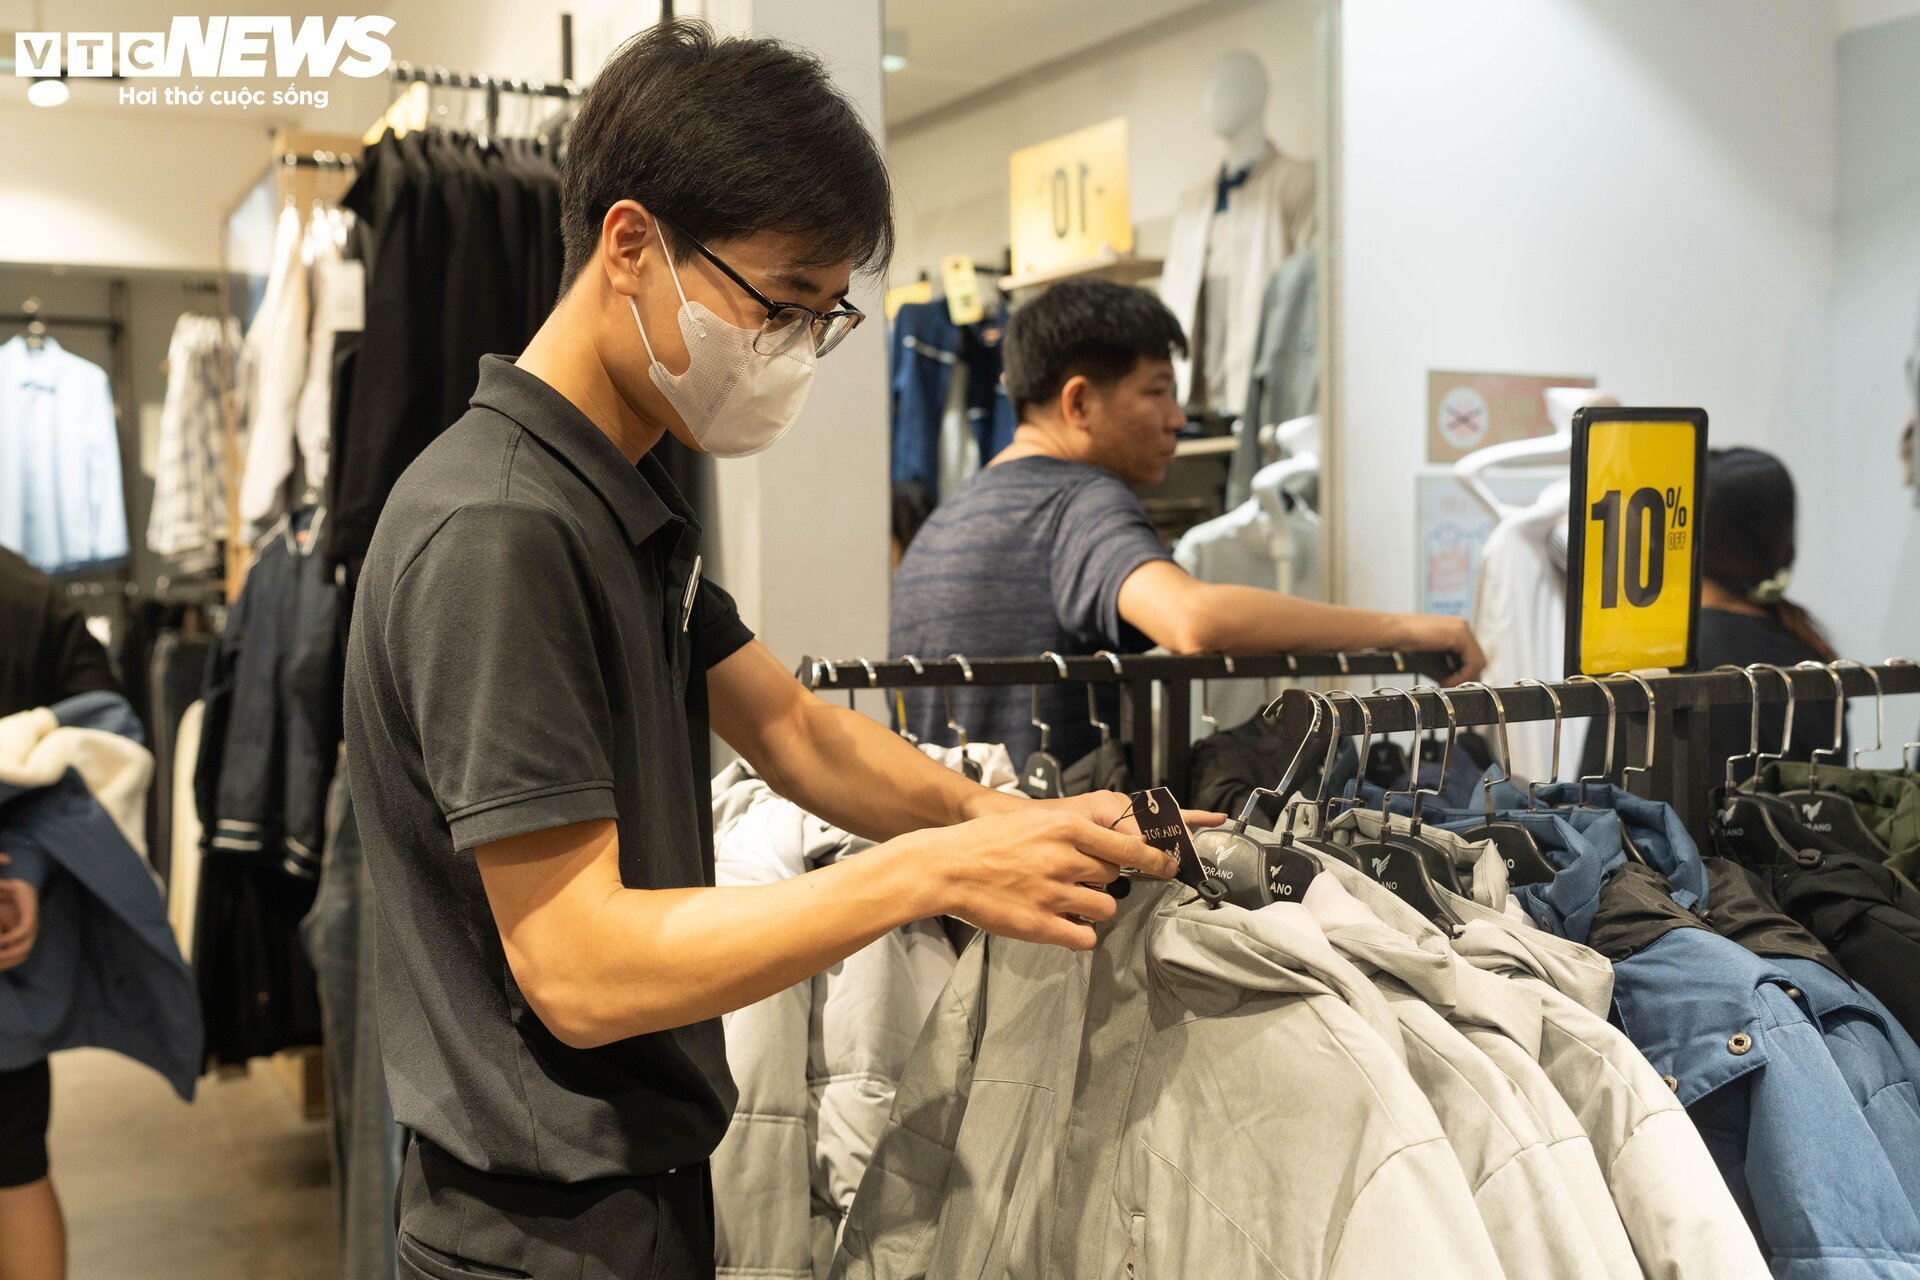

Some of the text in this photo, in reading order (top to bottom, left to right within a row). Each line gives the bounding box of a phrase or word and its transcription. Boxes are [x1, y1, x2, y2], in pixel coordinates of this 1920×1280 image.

[1667, 531, 1686, 551] OFF
[1144, 824, 1182, 841] TORANO
[1269, 882, 1292, 896] ANO
